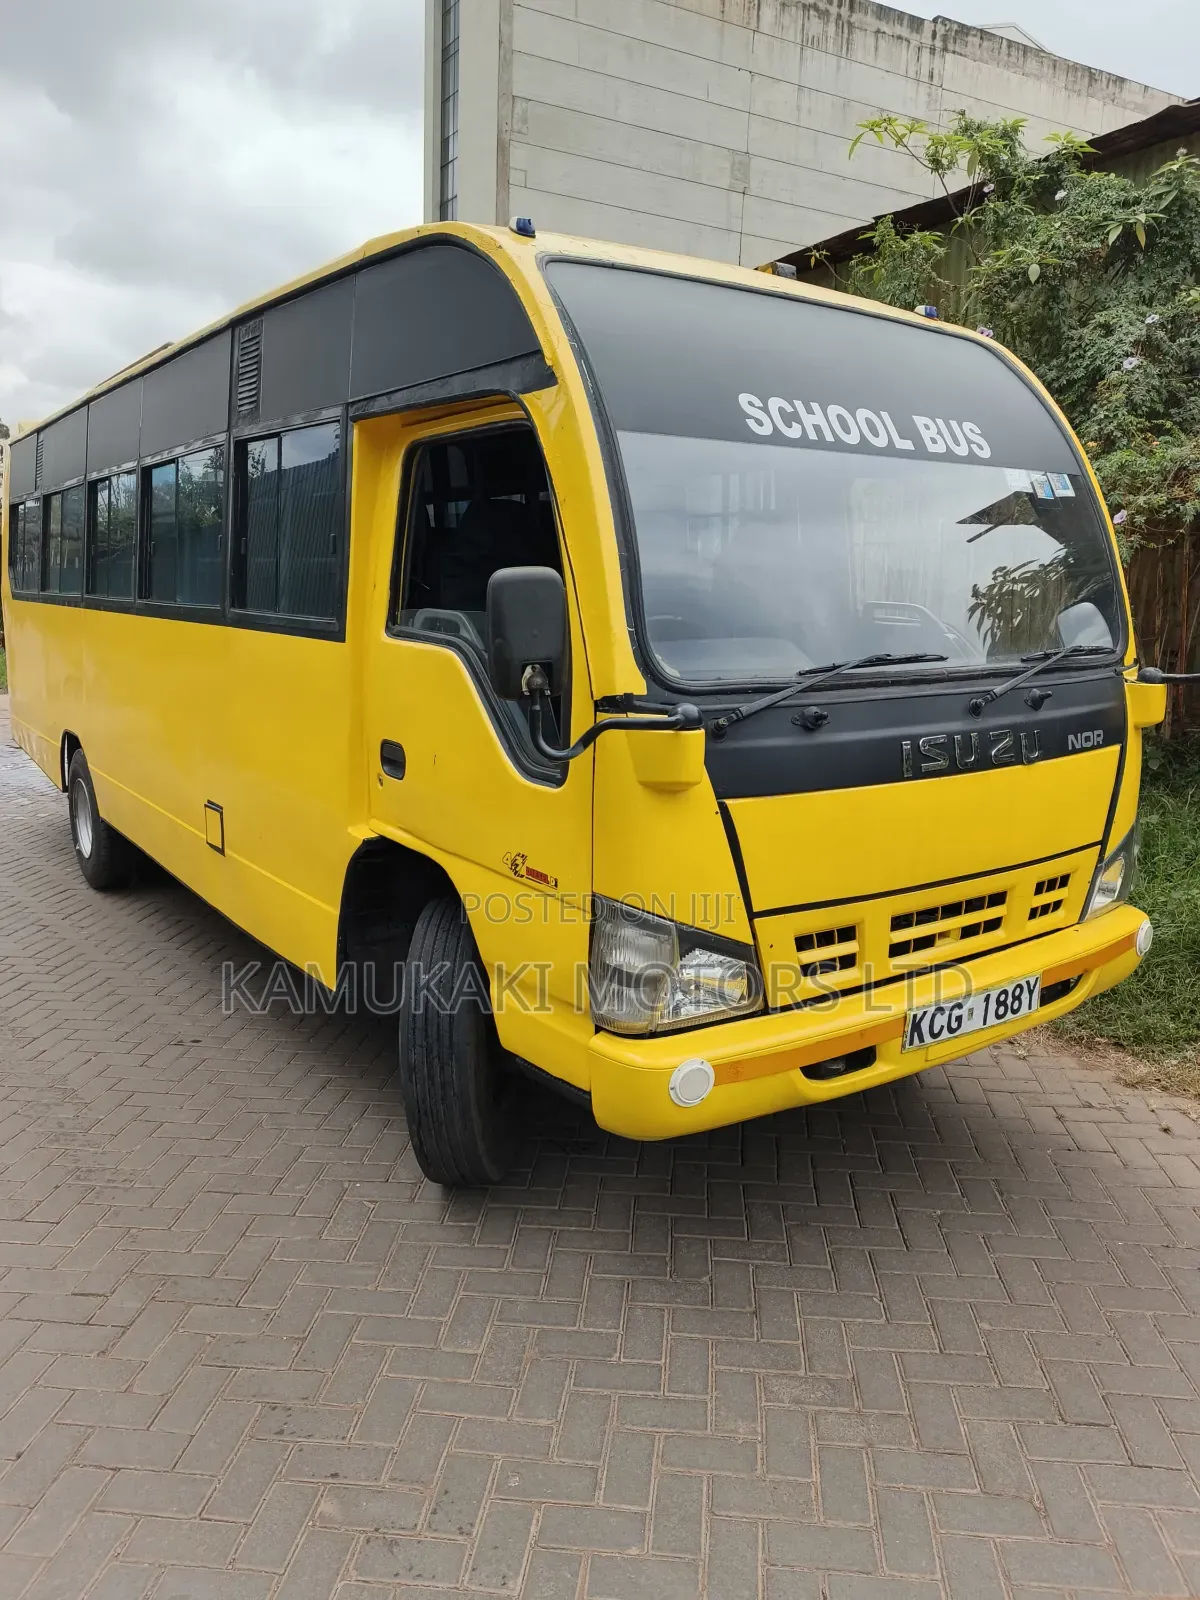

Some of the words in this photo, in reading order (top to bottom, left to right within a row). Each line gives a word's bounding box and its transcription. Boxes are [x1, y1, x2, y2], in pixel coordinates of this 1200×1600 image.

[738, 393, 915, 450] SCHOOL
[912, 415, 991, 458] BUS
[902, 730, 1042, 777] ISUZU
[908, 1002, 963, 1046] KCG
[982, 977, 1039, 1025] 188Y
